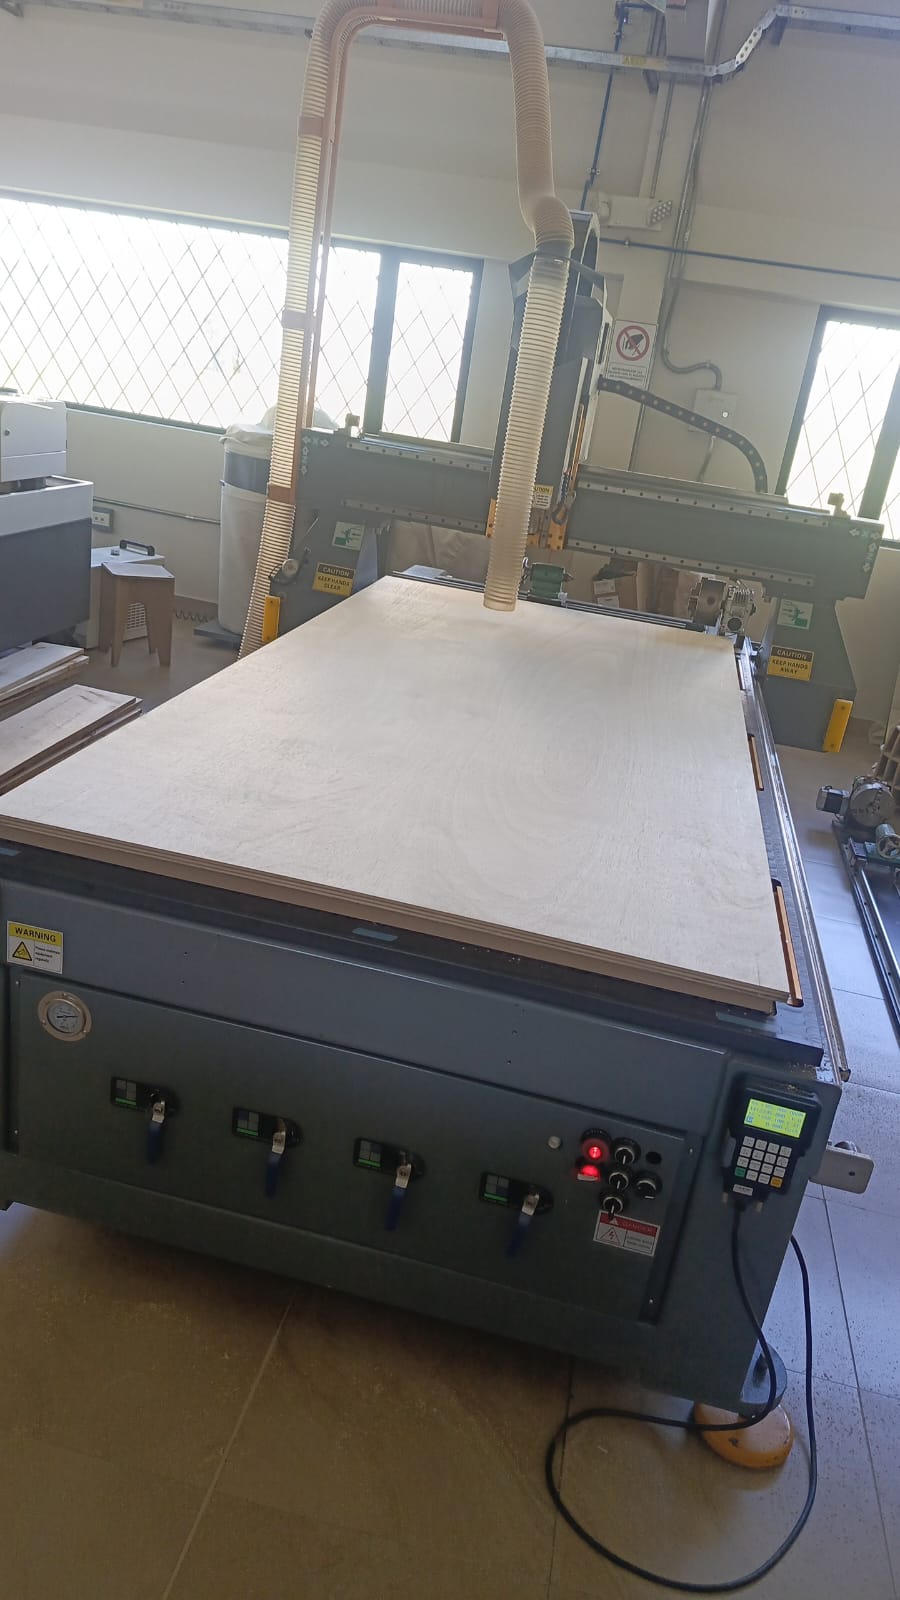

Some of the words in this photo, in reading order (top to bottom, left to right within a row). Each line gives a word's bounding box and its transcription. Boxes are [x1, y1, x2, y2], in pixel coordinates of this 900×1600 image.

[323, 567, 350, 577] CAUTION
[331, 577, 350, 586] HANDS
[777, 649, 807, 660] CAUTION
[787, 661, 809, 670] HANDS
[780, 667, 797, 675] AWAY
[15, 927, 56, 942] WARNING
